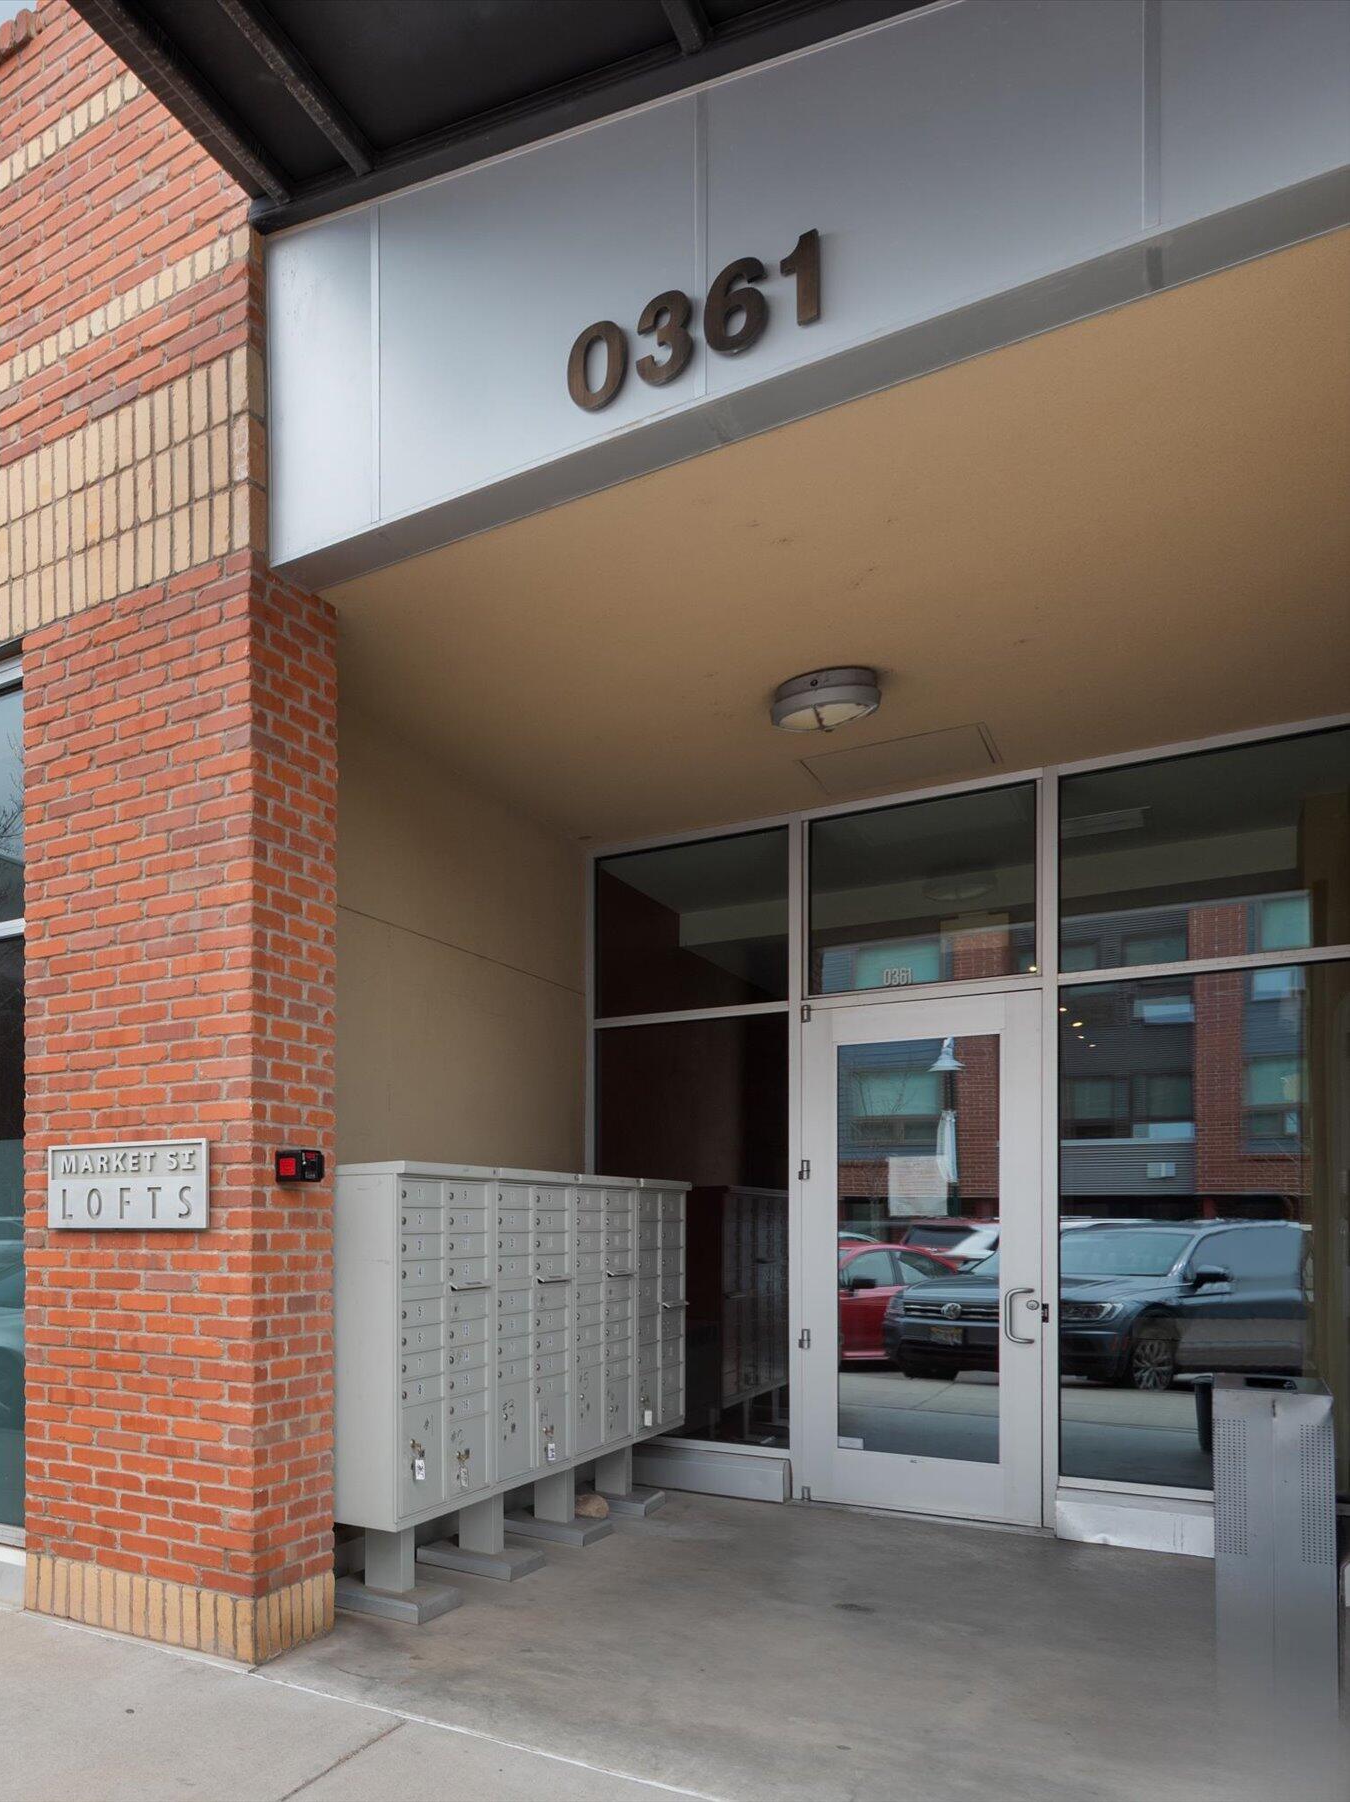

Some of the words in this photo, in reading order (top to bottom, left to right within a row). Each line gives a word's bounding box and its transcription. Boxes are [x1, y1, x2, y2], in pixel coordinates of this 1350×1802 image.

[566, 227, 822, 412] 0361
[883, 968, 913, 986] 0361
[61, 1151, 157, 1175] MARKET
[61, 1185, 193, 1220] LOFTS
